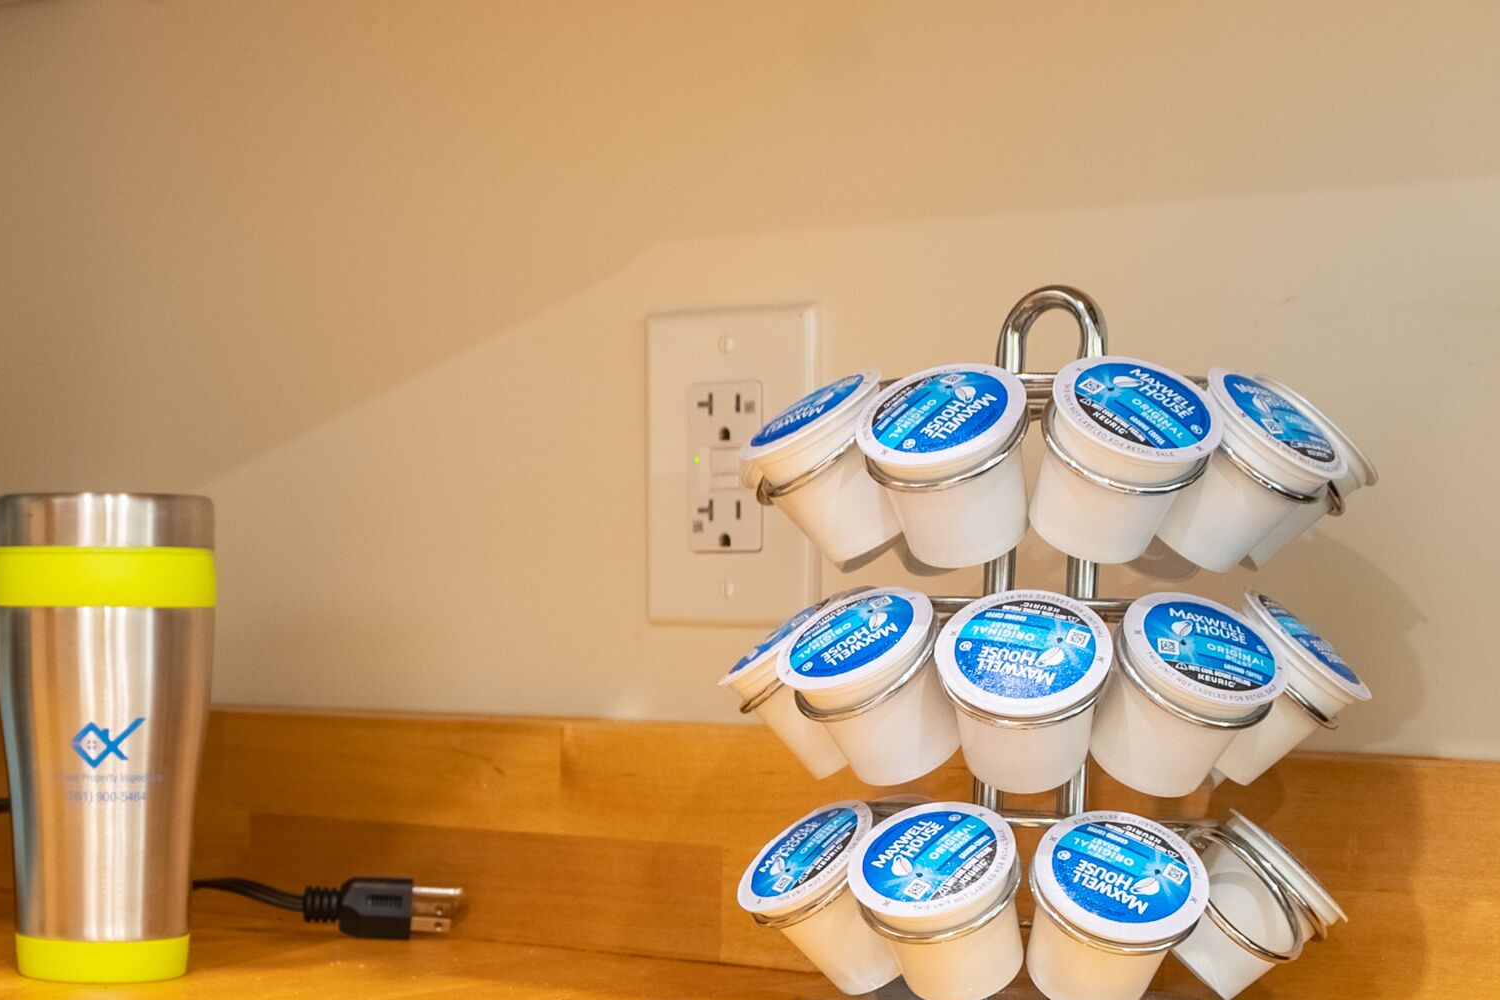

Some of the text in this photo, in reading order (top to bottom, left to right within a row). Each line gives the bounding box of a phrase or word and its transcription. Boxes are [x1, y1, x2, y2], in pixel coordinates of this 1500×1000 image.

[1129, 368, 1197, 414] MAXWELL
[1138, 384, 1191, 418] HOUSE
[920, 400, 966, 436] HOUSE
[932, 393, 997, 440] MAXWELL
[1091, 411, 1128, 434] KEURIG
[1130, 398, 1183, 438] ORIGINAL
[1023, 602, 1060, 613] KEURIG
[1170, 608, 1245, 637] MAXWELL
[821, 627, 870, 661] HOUSE
[826, 622, 898, 666] MAXWELL
[973, 626, 1035, 642] ORIGINAL
[1196, 623, 1247, 645] HOUSE
[979, 646, 1034, 665] HOUSE
[1206, 643, 1263, 666] ORIGINAL
[976, 657, 1057, 685] MAXWELL
[1198, 674, 1236, 687] KEURIG
[759, 824, 811, 872] MAXWELL
[871, 820, 934, 868] MAXWELL
[900, 822, 943, 857] HOUSE
[929, 825, 977, 859] ORIGINAL
[1126, 825, 1161, 844] KEURIG
[816, 842, 844, 870] KEURIG
[1074, 838, 1134, 866] ORIGINAL
[1076, 860, 1133, 890] HOUSE
[1072, 870, 1148, 915] MAXWELL
